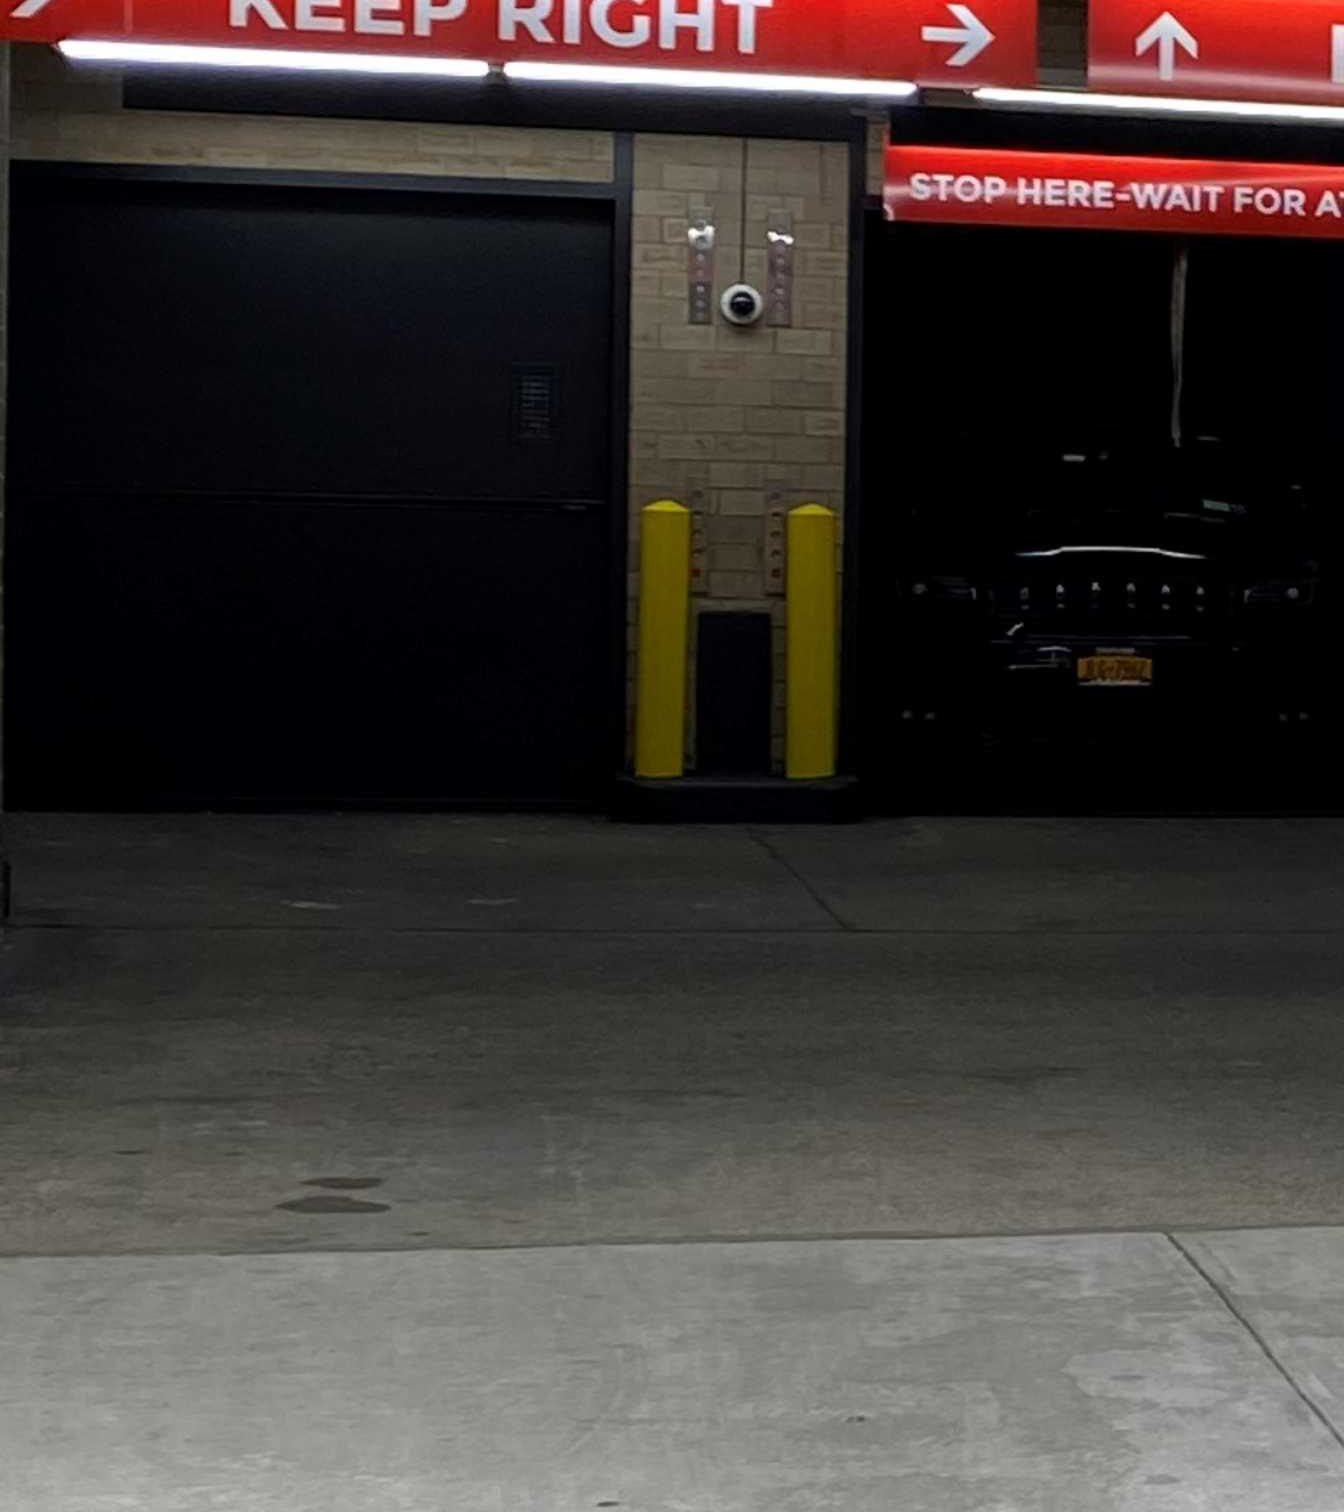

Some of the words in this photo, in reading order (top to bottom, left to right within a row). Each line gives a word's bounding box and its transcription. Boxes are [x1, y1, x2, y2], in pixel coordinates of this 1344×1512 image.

[909, 173, 1007, 203] STOP
[1016, 177, 1225, 212] HERE-WAIT
[1233, 187, 1306, 216] FOR
